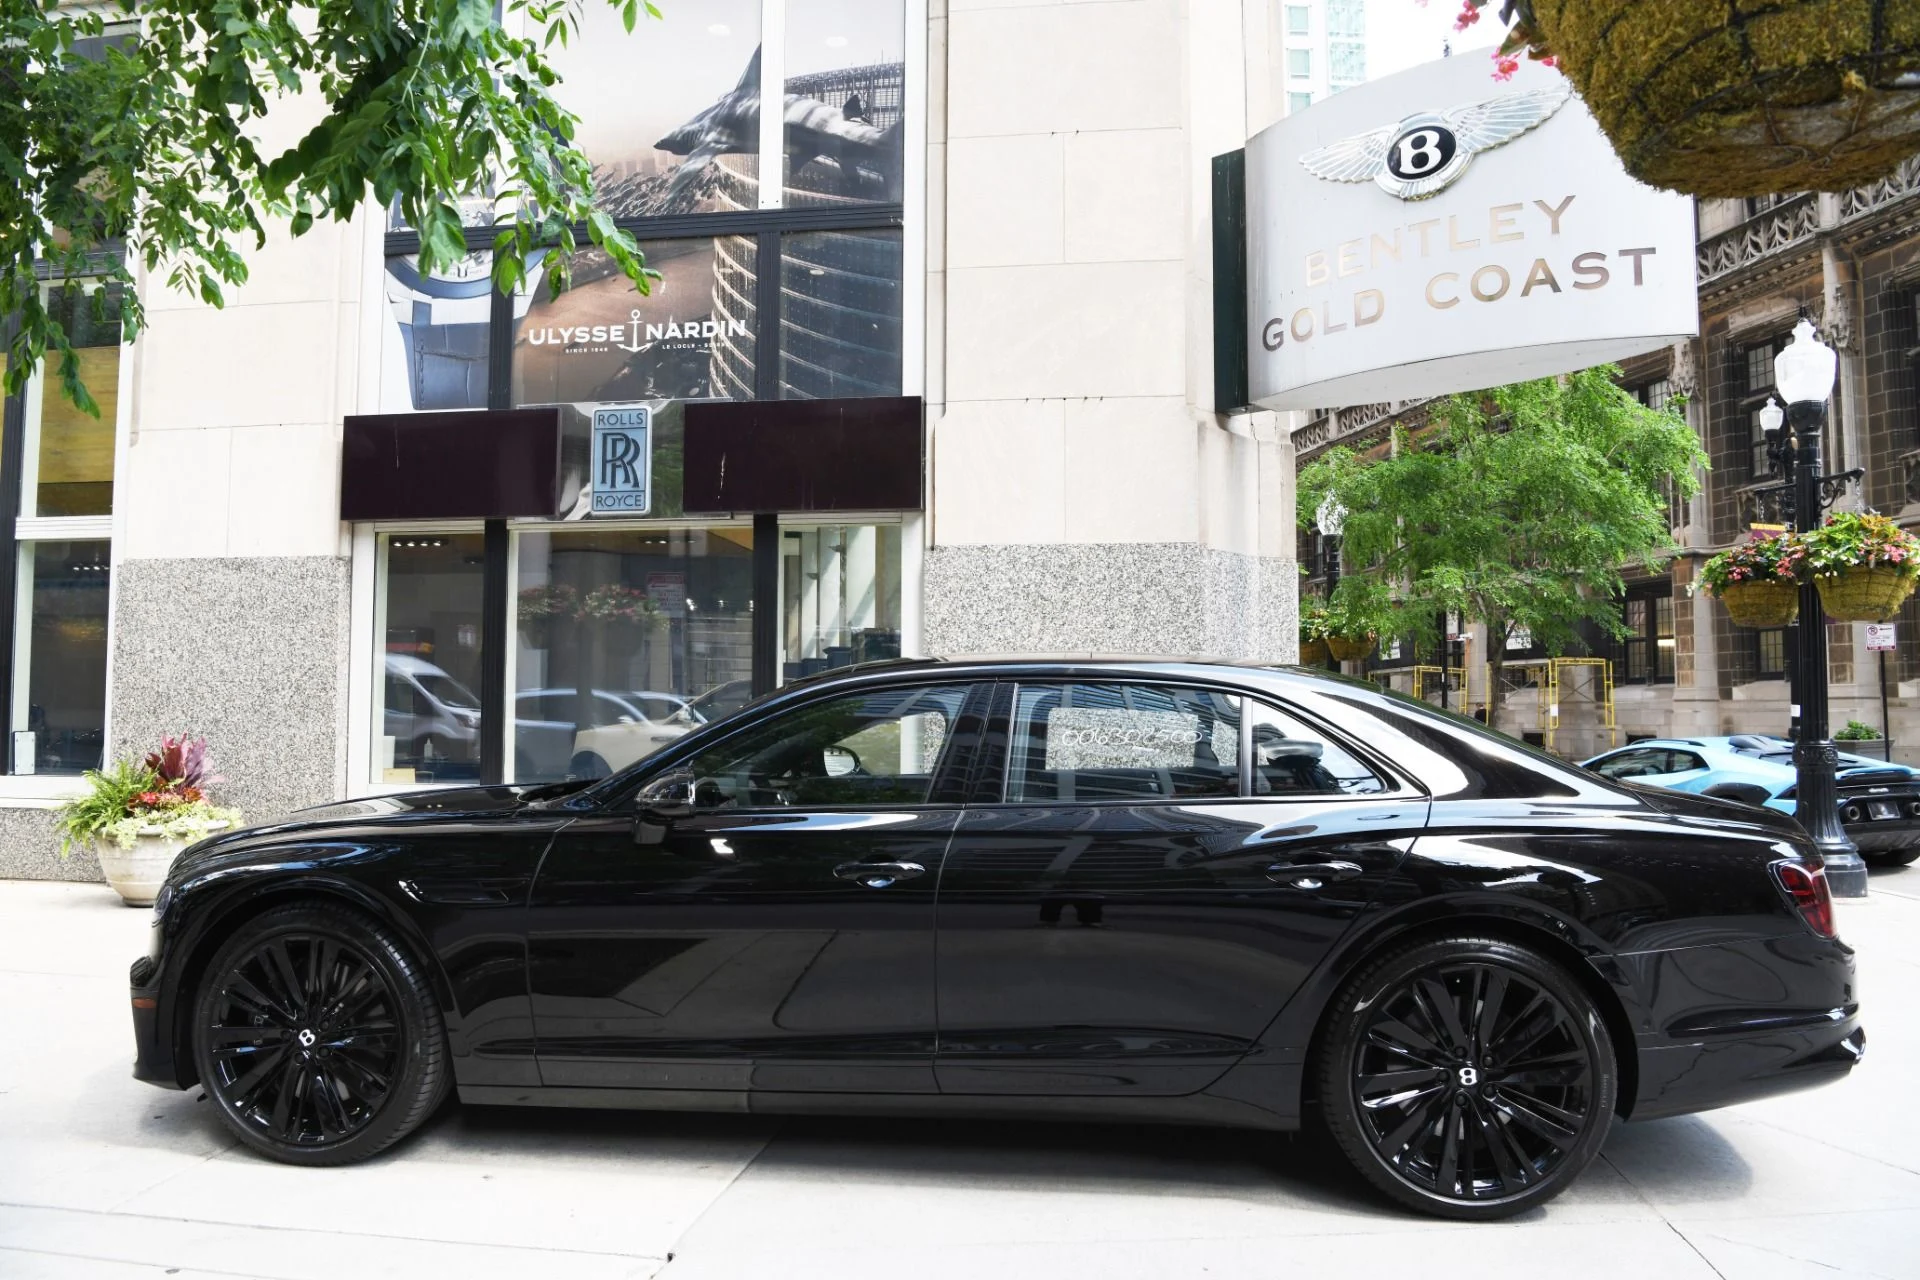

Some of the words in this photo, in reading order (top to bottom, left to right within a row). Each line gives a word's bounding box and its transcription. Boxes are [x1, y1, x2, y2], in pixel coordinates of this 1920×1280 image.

[1398, 130, 1442, 174] B
[1304, 195, 1577, 288] BENTLEY
[1262, 288, 1385, 352] GOLD
[1425, 247, 1657, 310] COAST
[529, 325, 625, 345] ULYSSE
[646, 319, 746, 341] NARDIN
[598, 412, 644, 426] ROLLS
[601, 432, 641, 489] RR
[595, 495, 642, 508] ROYCE
